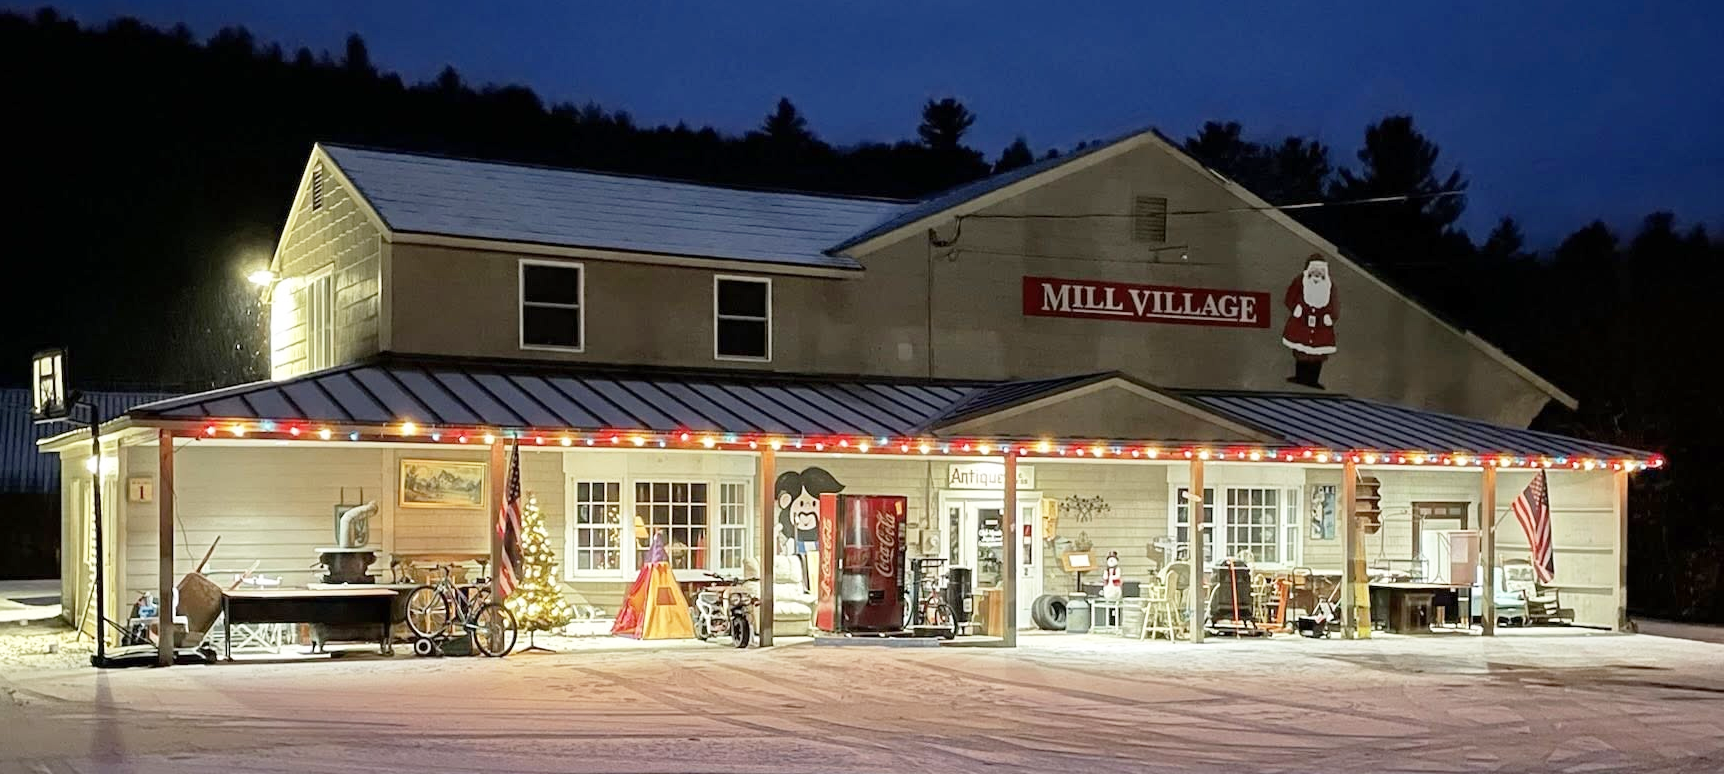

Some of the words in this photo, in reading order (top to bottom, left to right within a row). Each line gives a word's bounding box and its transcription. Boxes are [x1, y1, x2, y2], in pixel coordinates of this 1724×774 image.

[1041, 283, 1123, 312] MILL
[1128, 289, 1257, 323] VILLAGE
[950, 467, 1004, 487] Antique
